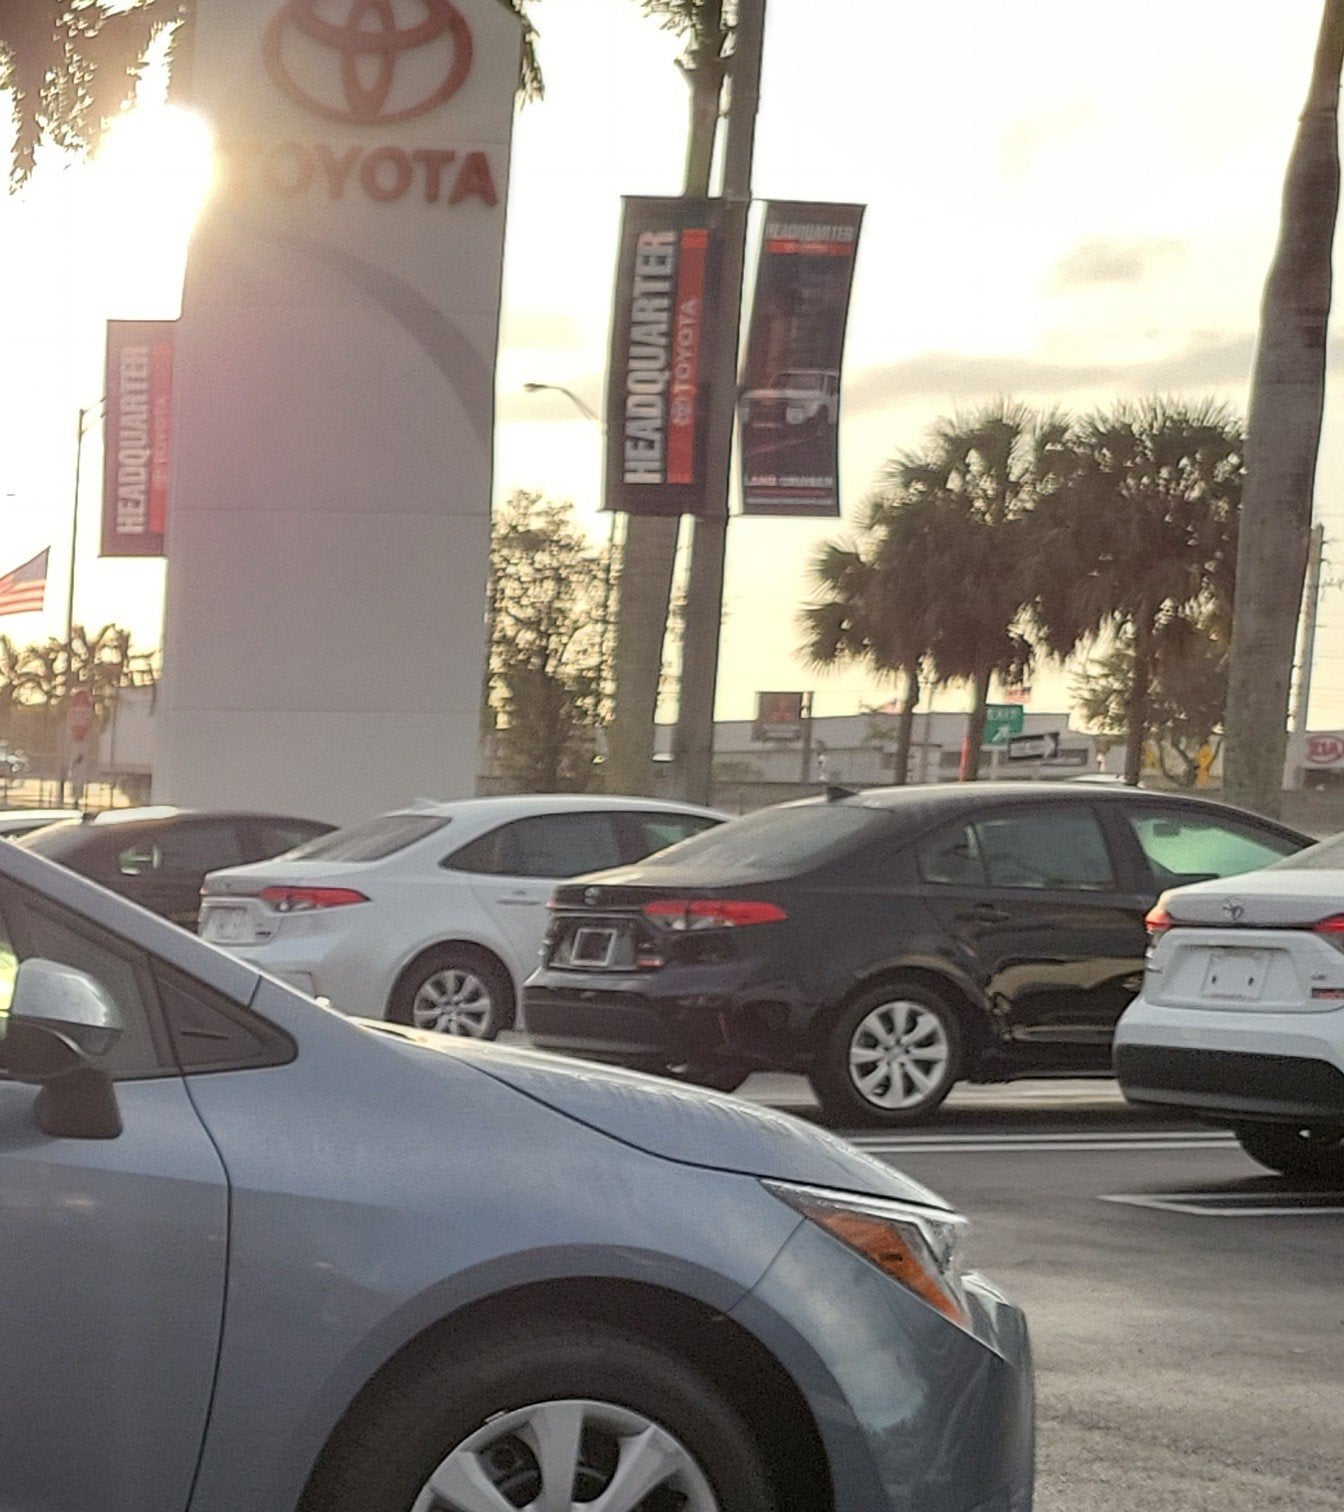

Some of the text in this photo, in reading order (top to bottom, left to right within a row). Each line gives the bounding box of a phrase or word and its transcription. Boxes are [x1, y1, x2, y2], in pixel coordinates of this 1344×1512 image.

[623, 231, 676, 484] HEADQUARTER
[674, 297, 697, 392] TOYOTA
[116, 347, 151, 534] HEADQUARTER
